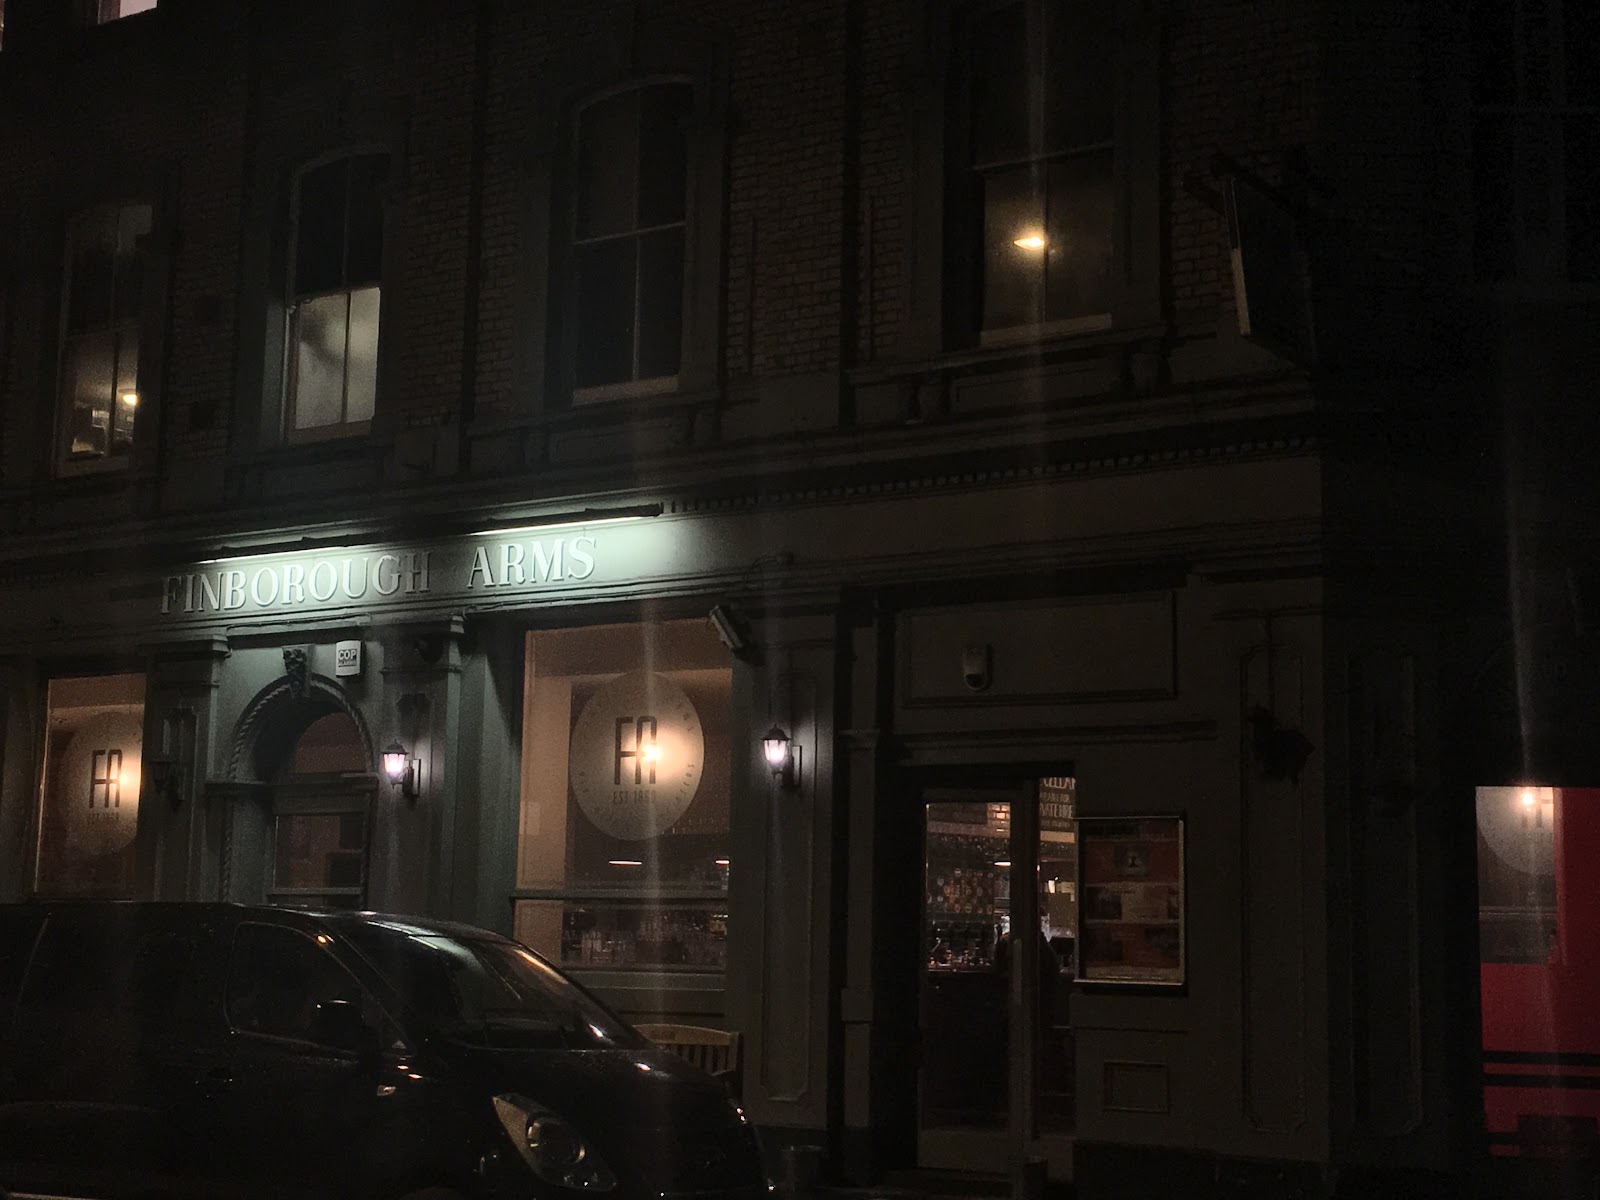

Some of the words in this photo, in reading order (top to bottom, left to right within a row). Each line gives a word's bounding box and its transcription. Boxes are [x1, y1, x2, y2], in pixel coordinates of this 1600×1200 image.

[161, 551, 431, 615] FINBOROUGH
[467, 535, 598, 589] ARMS
[338, 649, 357, 661] COP
